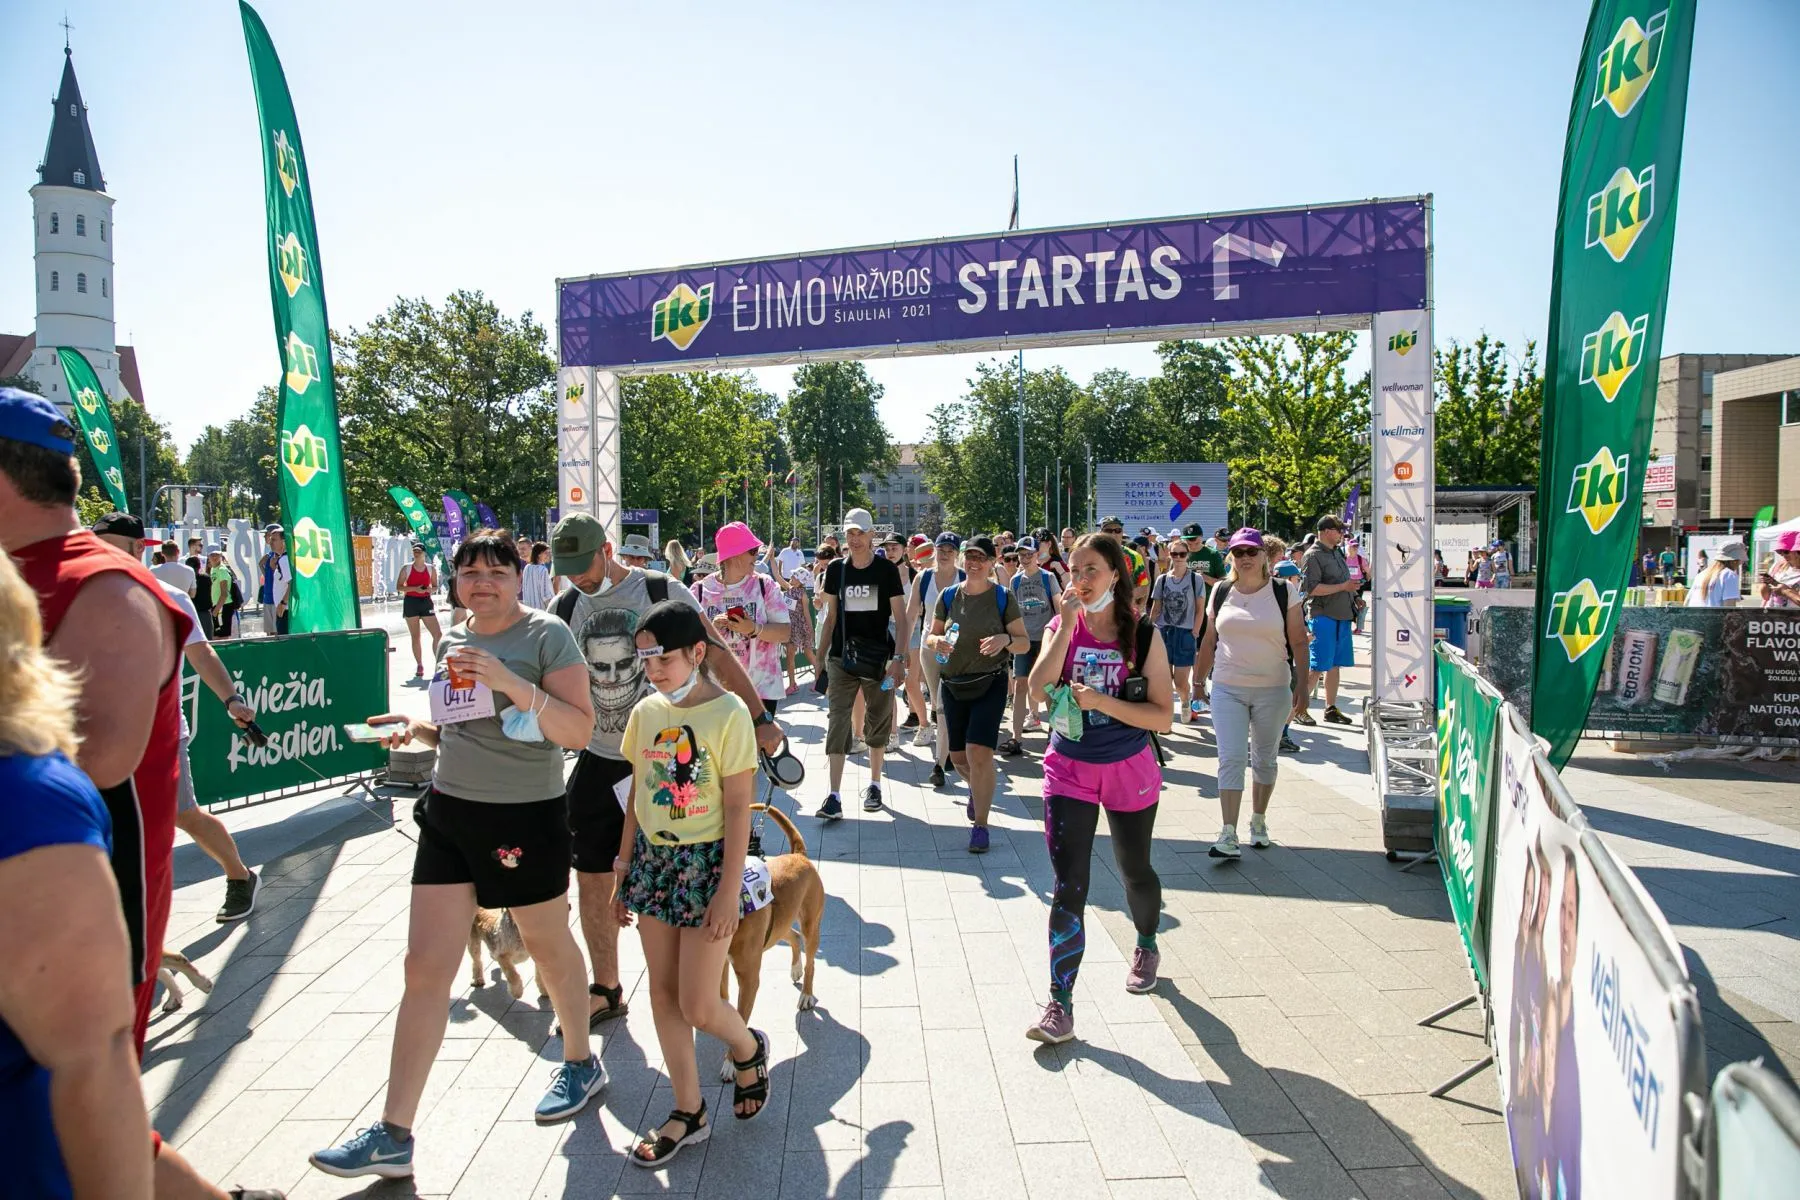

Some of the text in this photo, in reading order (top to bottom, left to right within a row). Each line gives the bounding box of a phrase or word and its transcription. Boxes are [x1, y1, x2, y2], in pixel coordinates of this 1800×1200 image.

[1593, 11, 1667, 108] iki
[1585, 165, 1655, 249] iki
[957, 245, 1182, 314] STARTAS
[733, 266, 931, 332] ĖJIMO VARŽYBOS
[652, 284, 713, 341] iki
[834, 303, 931, 324] ŠIAULIAI 2021
[1388, 330, 1417, 351] iki
[1578, 314, 1649, 385] iki
[565, 383, 584, 400] iki
[1382, 382, 1424, 392] wellwoman
[1566, 454, 1630, 513] iki
[1395, 515, 1425, 523] ŠIAULIAI
[1187, 560, 1210, 569] LGIRIS
[845, 585, 870, 598] 605
[1546, 590, 1617, 639] iki
[1748, 621, 1800, 635] BORJ
[1746, 638, 1800, 649] FLAVO
[1773, 651, 1800, 661] WA
[1072, 664, 1121, 686] PK
[1623, 640, 1645, 699] BORJOMI
[1774, 693, 1800, 702] KUP
